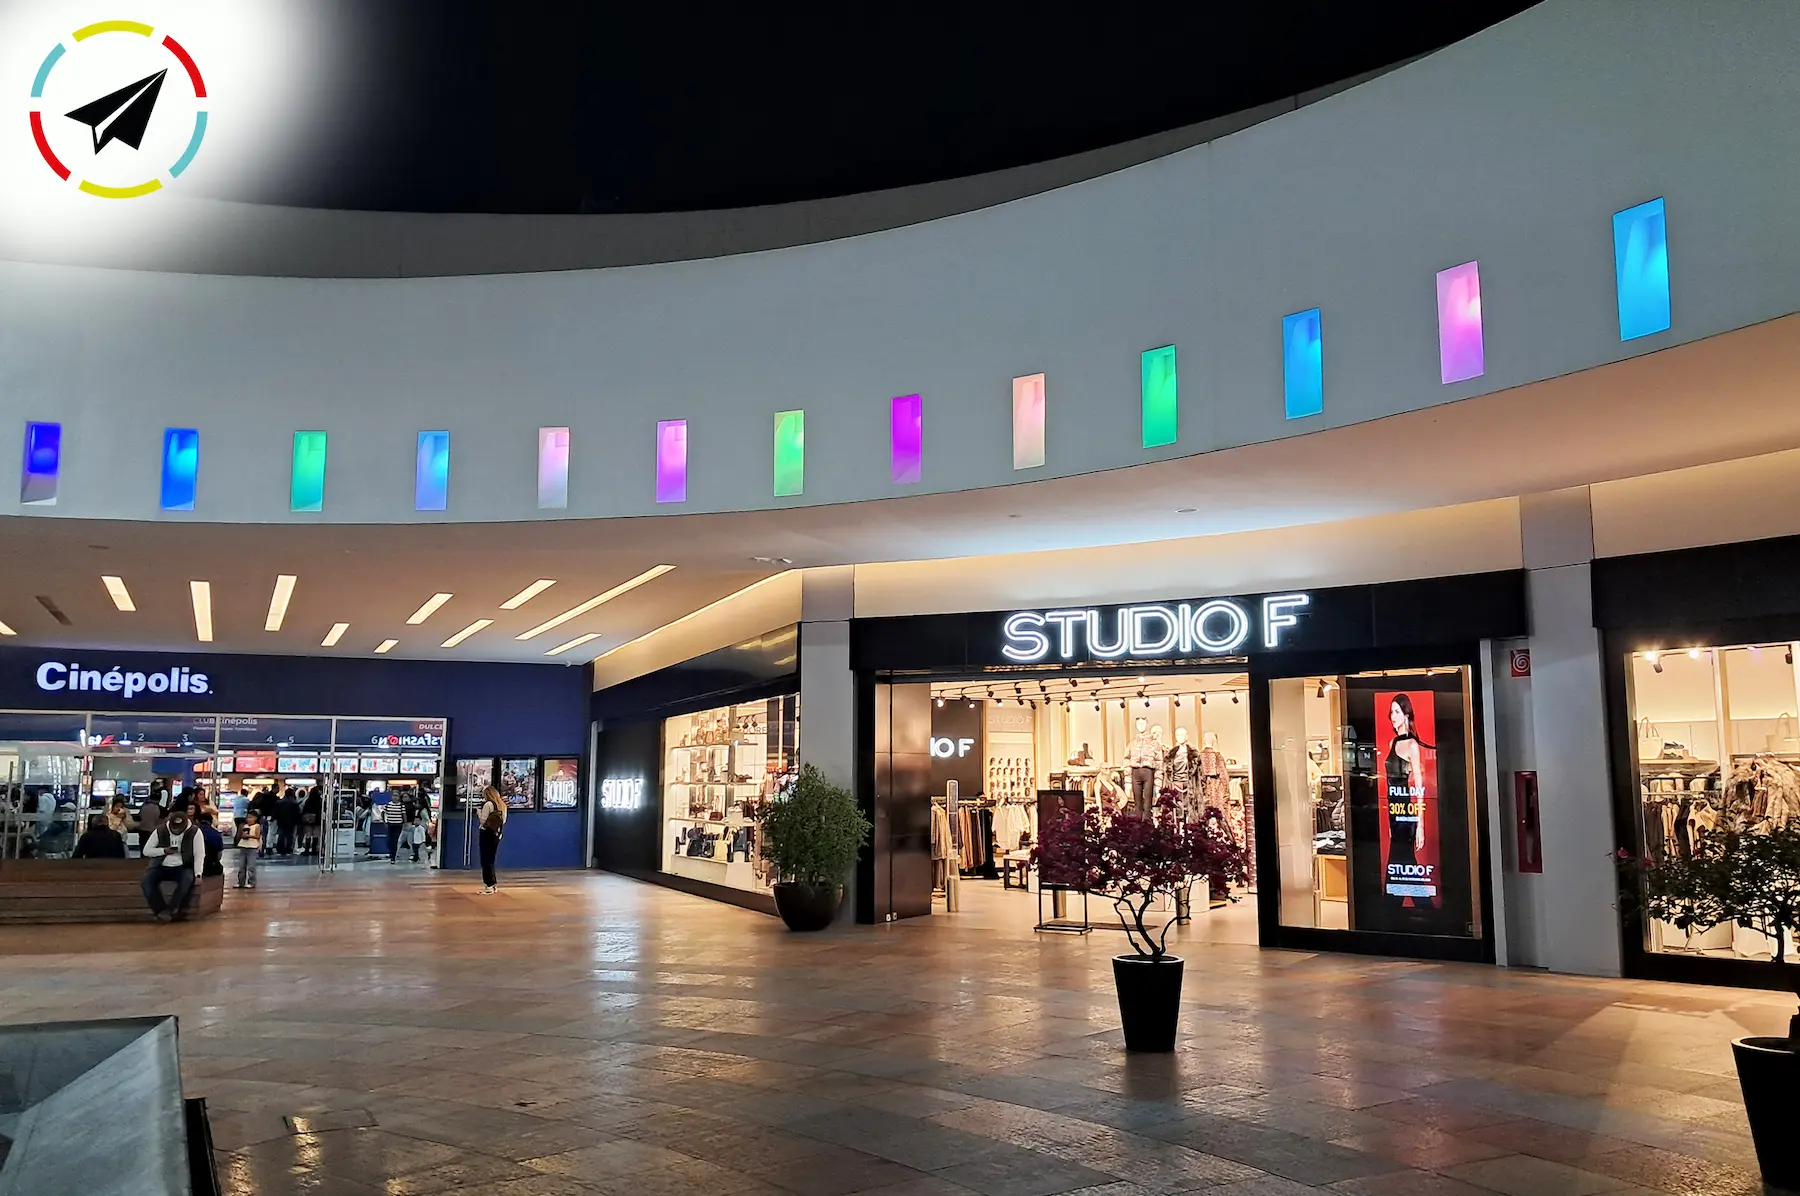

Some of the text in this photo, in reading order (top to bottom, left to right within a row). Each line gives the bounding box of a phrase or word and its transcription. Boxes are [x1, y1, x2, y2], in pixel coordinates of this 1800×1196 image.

[1002, 594, 1309, 661] STUDIO F
[193, 717, 257, 726] CLUB inépolis
[138, 733, 145, 741] 2
[182, 733, 189, 742] 3
[266, 735, 274, 743] 4
[288, 736, 295, 744] 5
[958, 738, 975, 758] F
[1389, 786, 1425, 796] FULL DAY
[1389, 802, 1426, 815] 30% OFF
[1387, 863, 1434, 876] STUDIO F
